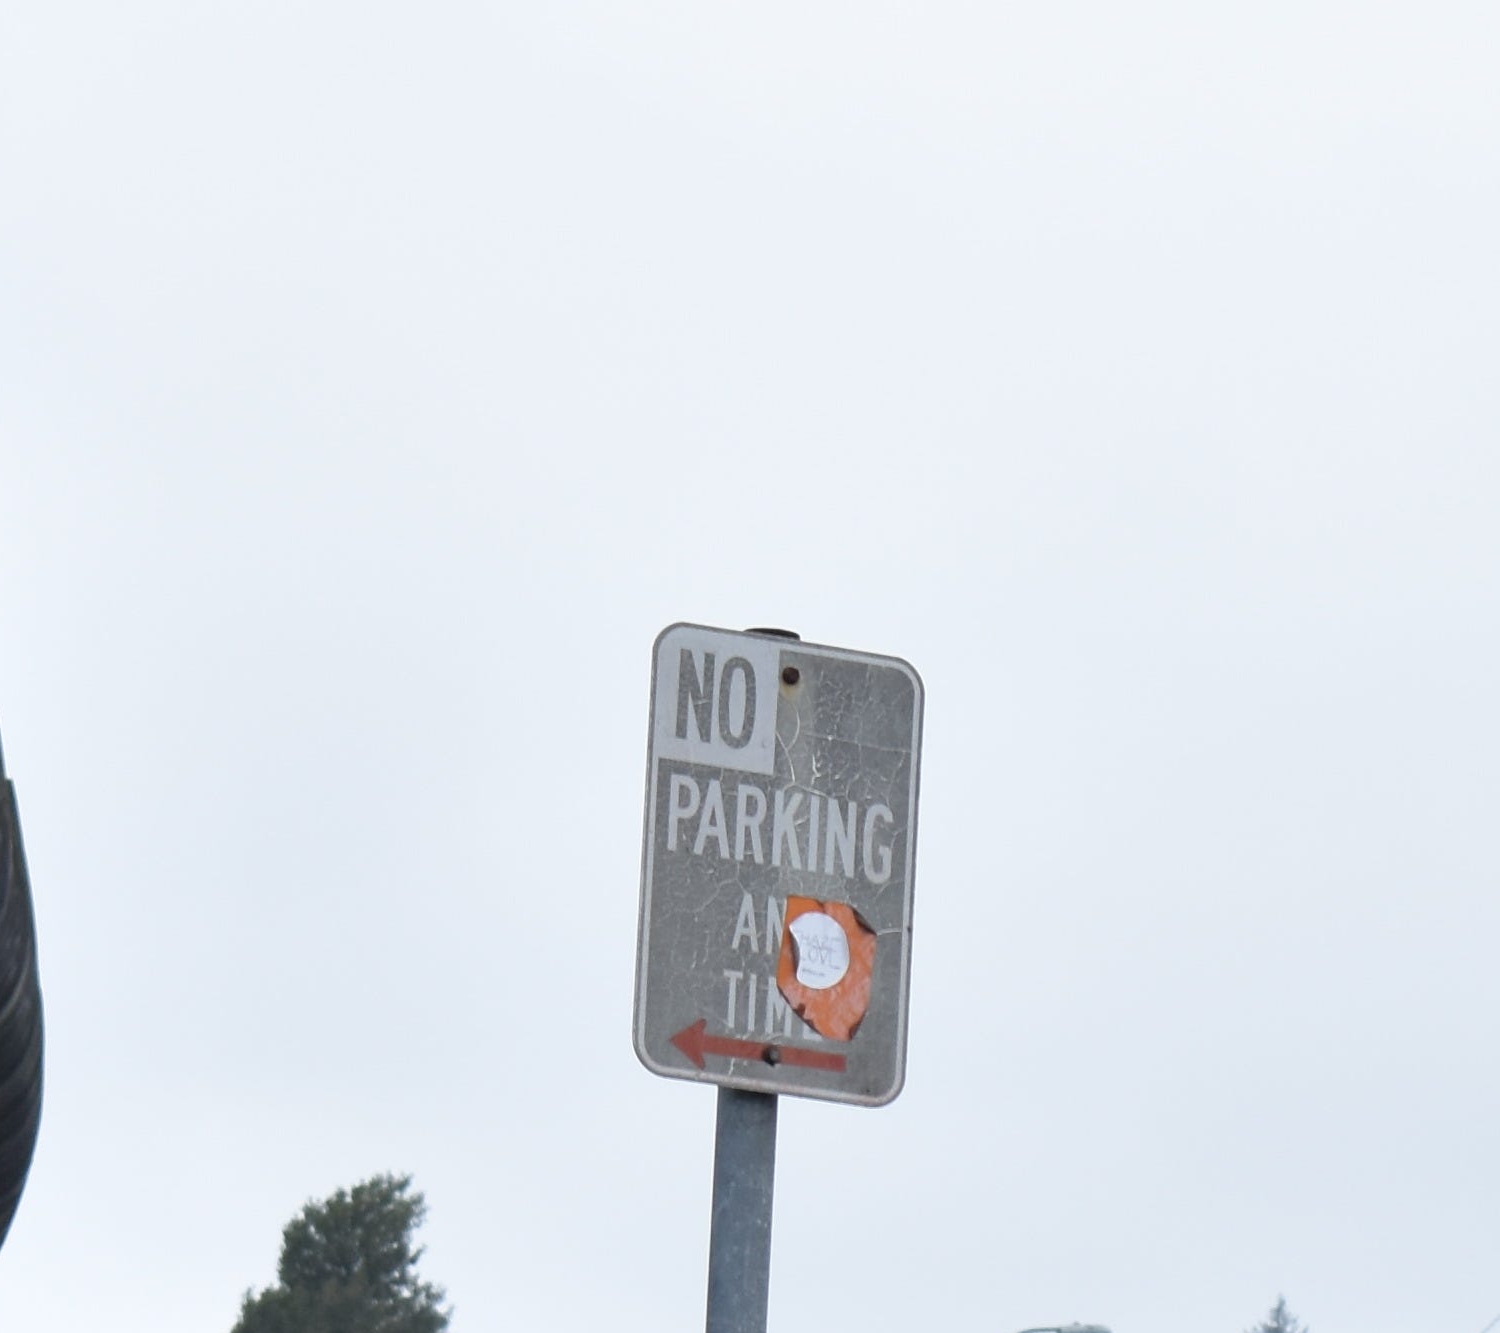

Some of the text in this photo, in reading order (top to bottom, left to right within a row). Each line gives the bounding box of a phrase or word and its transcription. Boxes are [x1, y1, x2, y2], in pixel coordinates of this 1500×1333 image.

[674, 648, 757, 750] NO
[666, 774, 894, 884] PARKING
[731, 893, 788, 955] AN
[723, 967, 823, 1042] TIM
